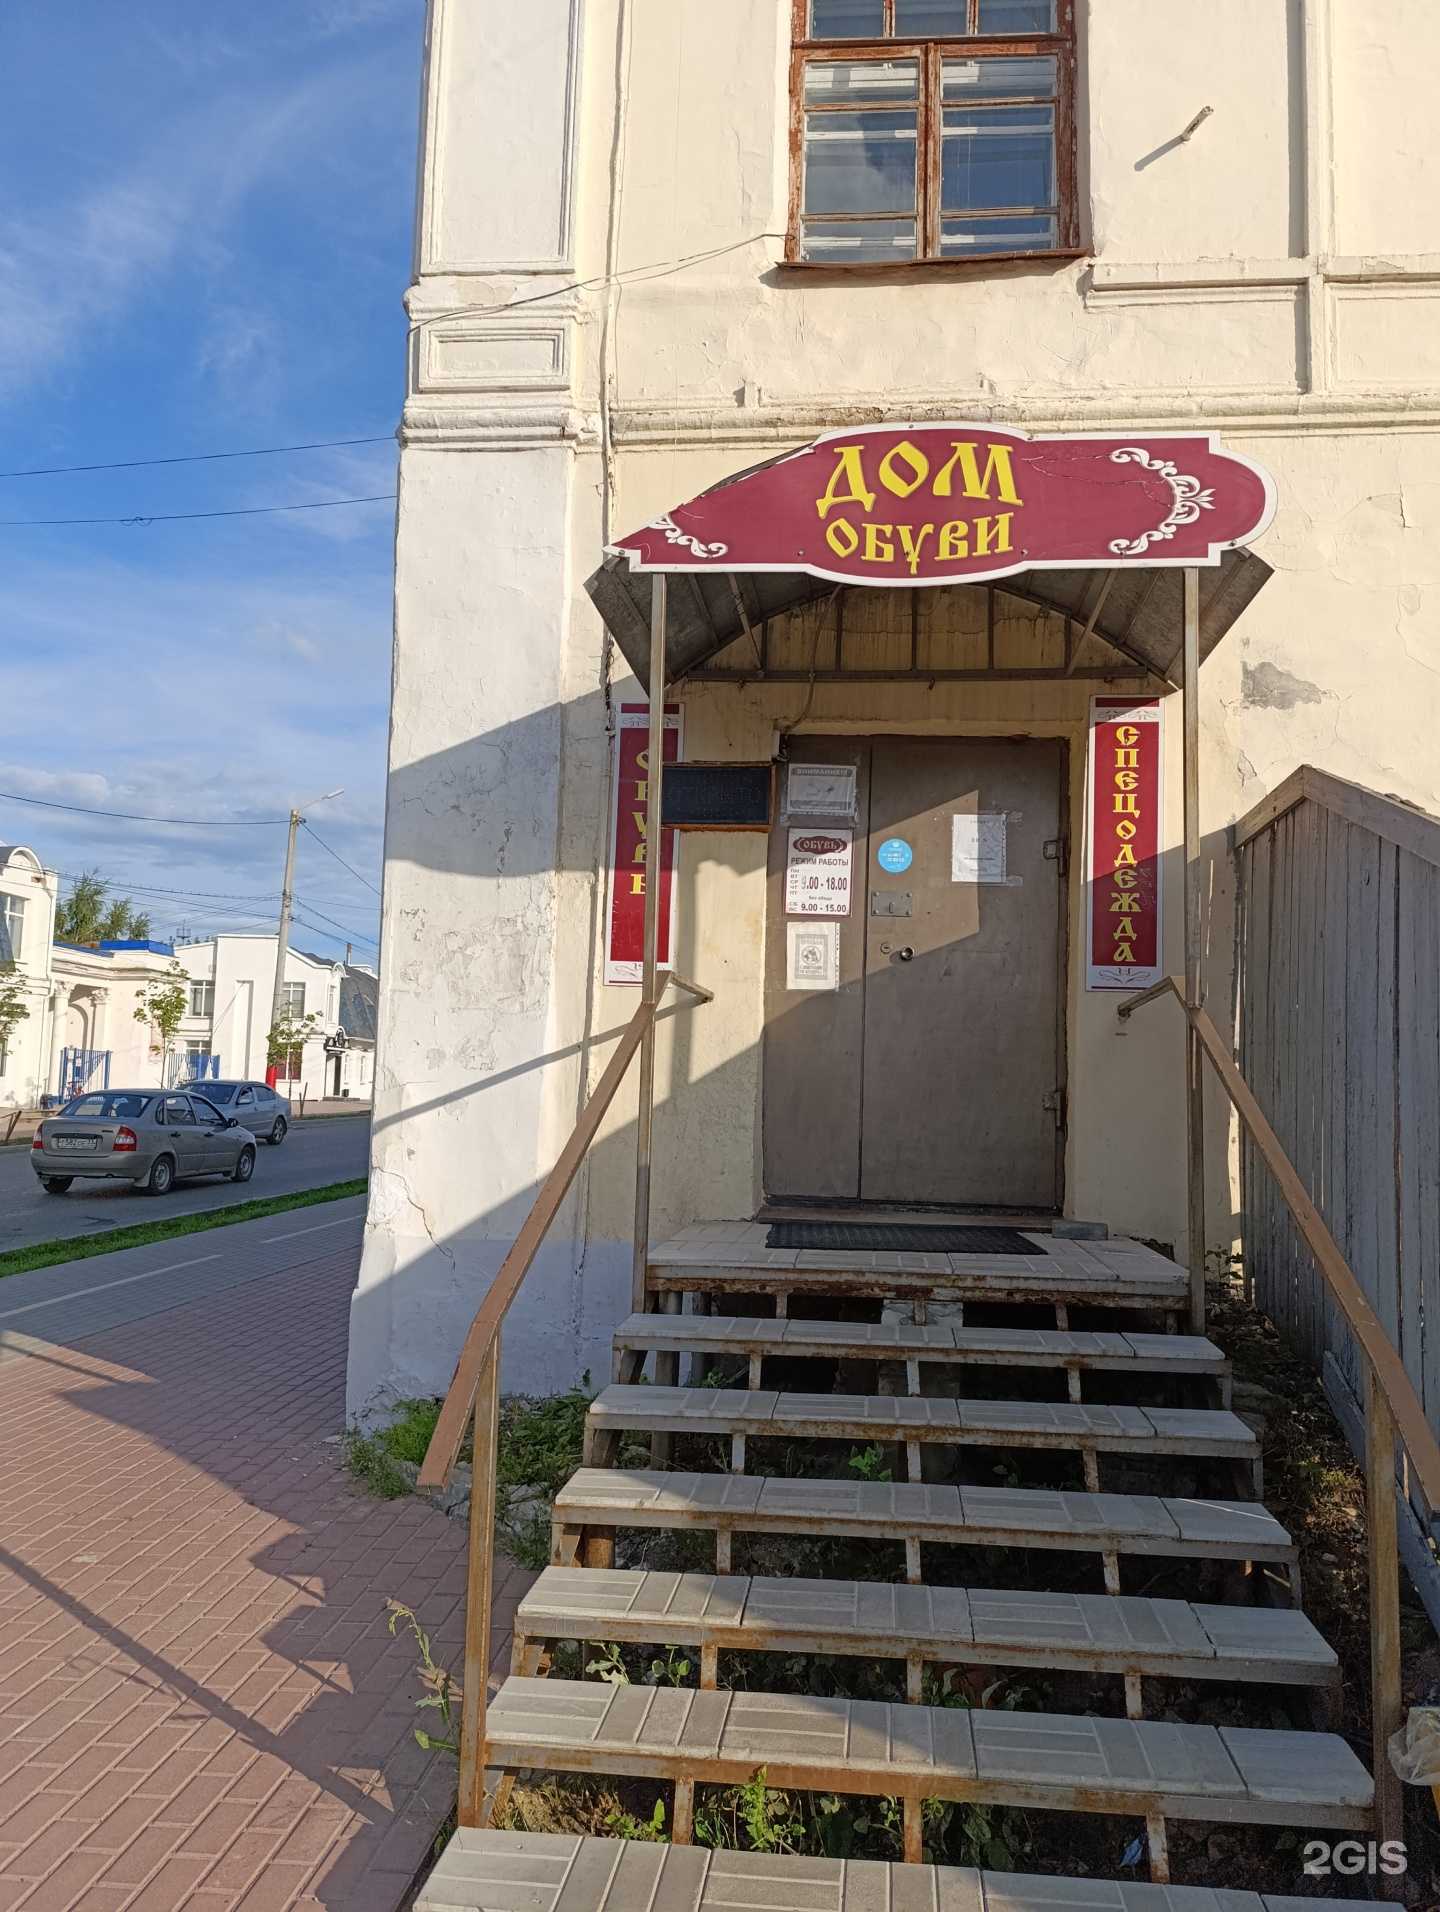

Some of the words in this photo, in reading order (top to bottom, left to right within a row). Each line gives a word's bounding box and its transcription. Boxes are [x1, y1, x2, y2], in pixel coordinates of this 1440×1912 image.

[815, 440, 1025, 519] ДОМ
[825, 512, 1015, 575] ОБУВИ
[802, 840, 838, 849] ОБУВЬ
[1108, 725, 1143, 962] СПЕЦОДЕЖДА
[790, 857, 817, 865] РЕЖИМ
[818, 858, 849, 866] РАБОТЫ
[826, 877, 848, 891] 18.00
[801, 903, 818, 912] 9.00
[825, 904, 847, 913] 15.00
